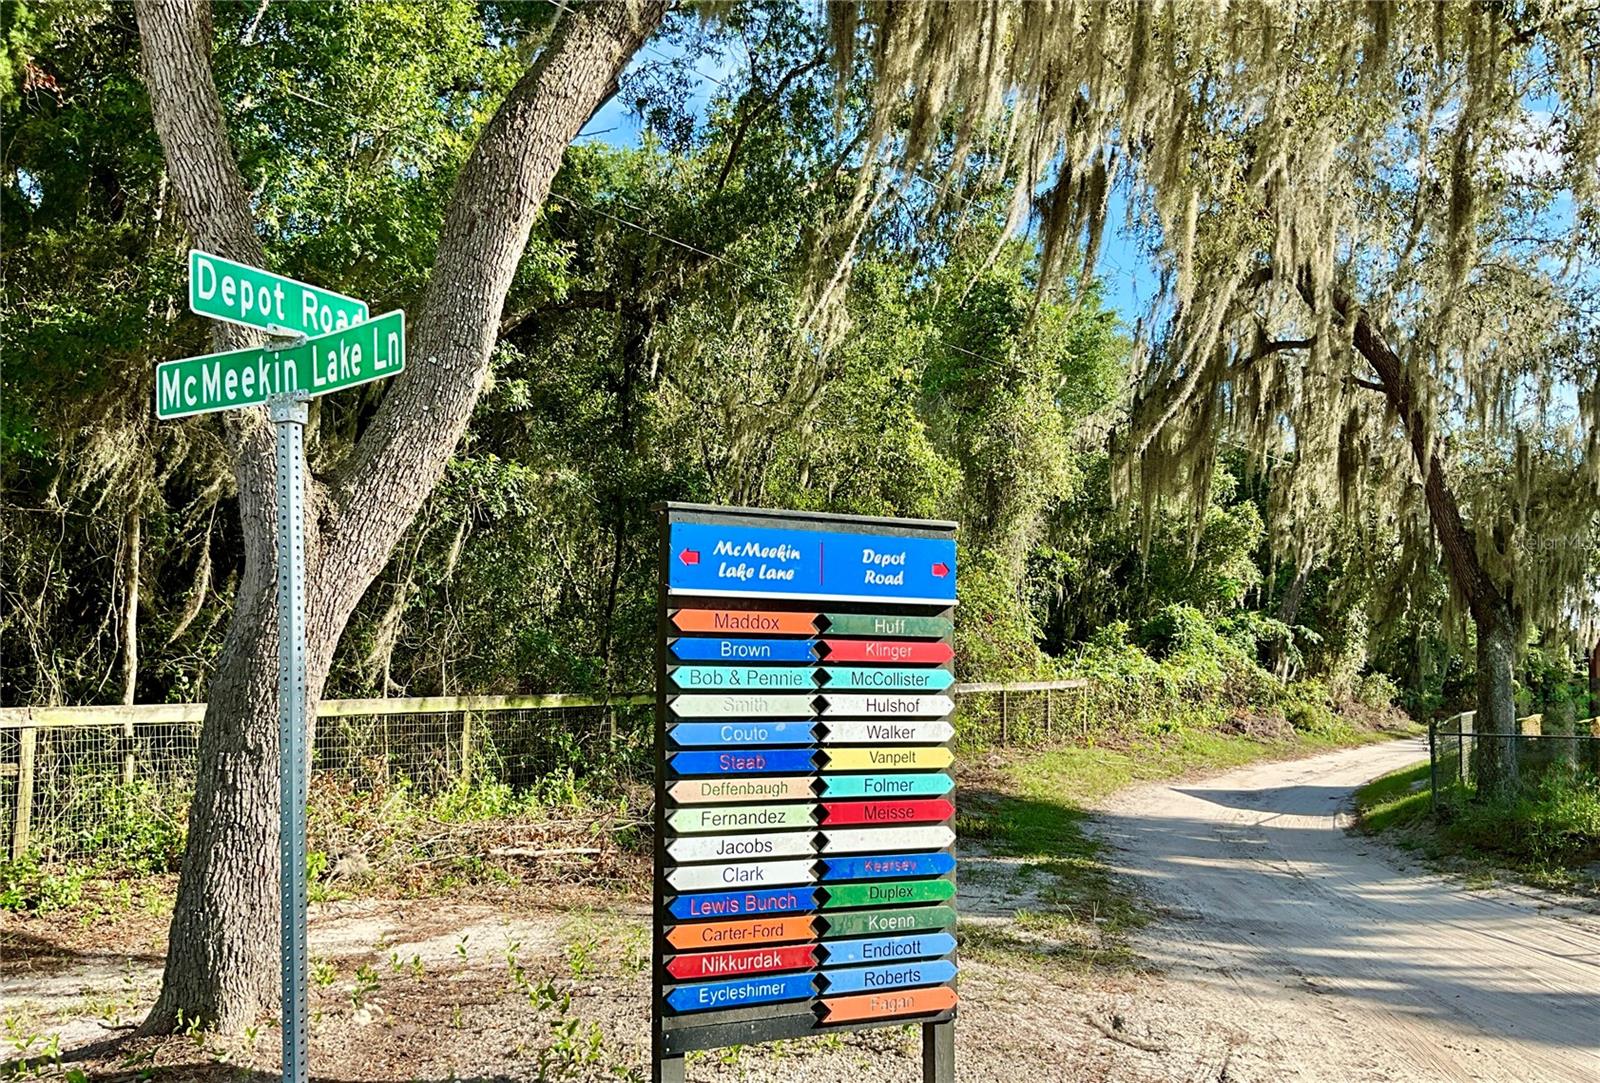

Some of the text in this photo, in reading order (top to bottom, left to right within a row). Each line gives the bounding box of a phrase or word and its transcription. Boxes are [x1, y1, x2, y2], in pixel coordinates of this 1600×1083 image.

[198, 260, 364, 333] Depot Road
[162, 327, 399, 410] McMeekin Lake Ln
[713, 540, 801, 561] McMeekin
[862, 549, 906, 566] Depot
[718, 562, 795, 581] Lake Lane
[865, 570, 903, 586] Road
[714, 613, 780, 631] Maddox
[875, 619, 906, 633] Huff
[721, 641, 771, 658] Brown
[865, 643, 913, 661] Klinger
[690, 669, 803, 686] Bob & Pennie
[851, 672, 930, 687] McCollister
[723, 697, 769, 713] Smith
[866, 698, 920, 713] Hulshof
[721, 726, 769, 741] Couto
[866, 725, 916, 740] Walker
[720, 754, 765, 769] Staab
[869, 751, 916, 767] Vanpelt
[701, 780, 788, 799] Deffenbaugh
[864, 778, 914, 793] Folmer
[701, 810, 786, 827] Fernandez
[864, 805, 915, 820] Meisse
[716, 839, 773, 855] Jacobs
[722, 867, 764, 884] Clark
[869, 884, 914, 901] Duplex
[690, 893, 797, 916] Lewis Bunch
[869, 914, 915, 931] Koenn
[702, 924, 784, 943] Carter-Ford
[863, 941, 921, 959] Endicott
[702, 952, 782, 974] Nikkurdak
[864, 968, 921, 987] Roberts
[699, 982, 786, 1005] Eycleshimer
[871, 995, 915, 1012] Fagan
